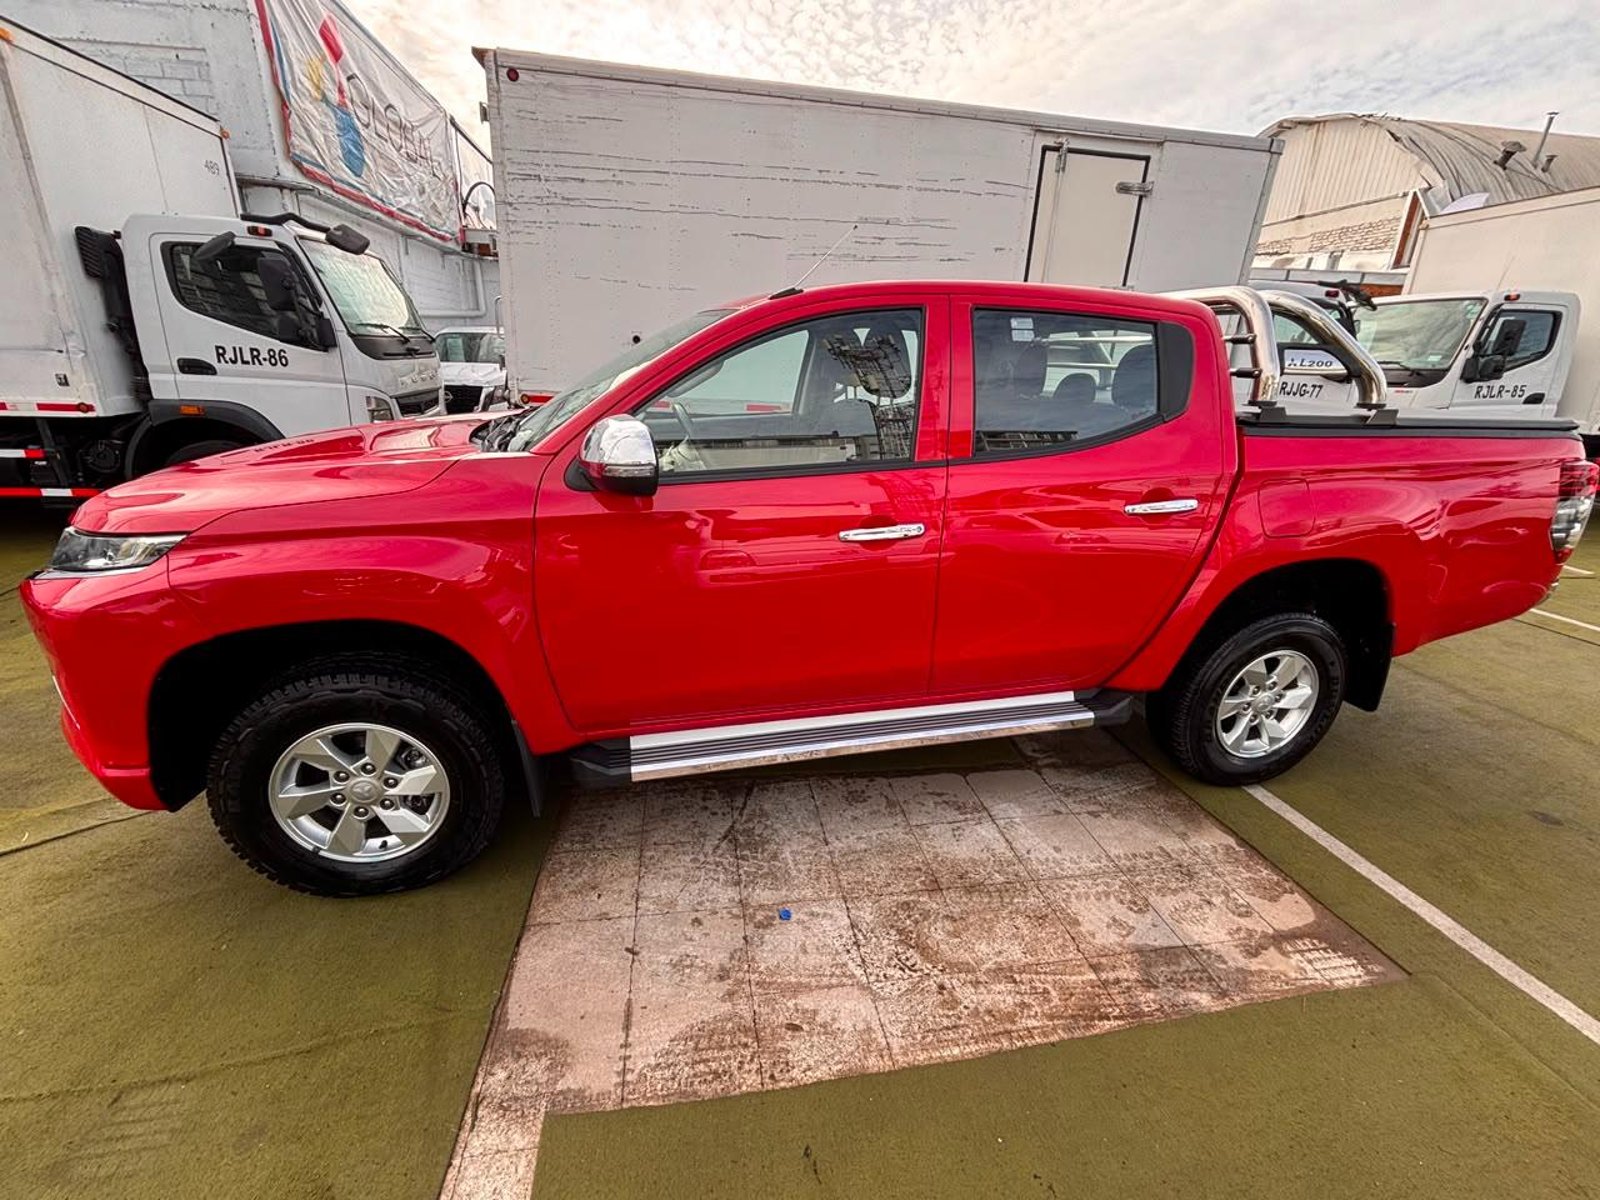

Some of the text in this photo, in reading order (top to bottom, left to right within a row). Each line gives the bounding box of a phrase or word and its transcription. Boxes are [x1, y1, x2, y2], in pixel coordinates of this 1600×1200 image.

[214, 345, 289, 367] RJLR-86
[1299, 358, 1333, 368] L200
[1280, 381, 1324, 399] RJJG-77
[1474, 384, 1527, 399] RJLR-85
